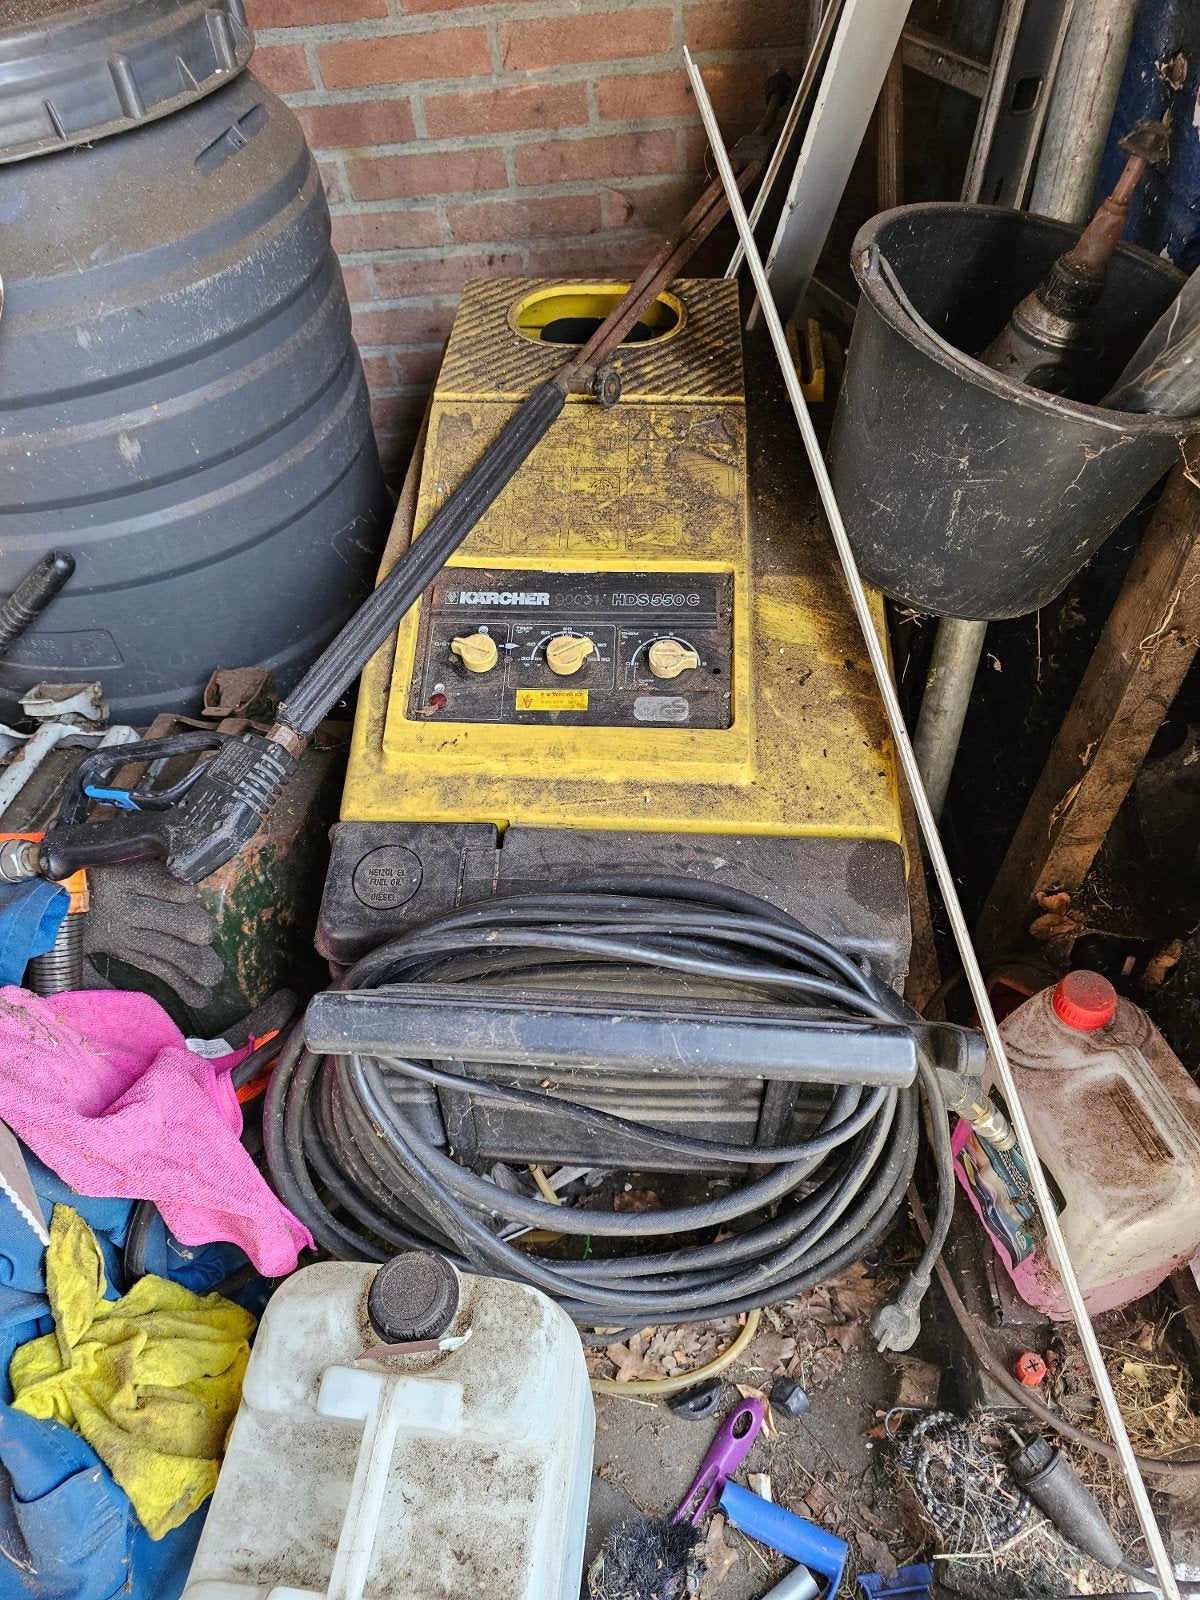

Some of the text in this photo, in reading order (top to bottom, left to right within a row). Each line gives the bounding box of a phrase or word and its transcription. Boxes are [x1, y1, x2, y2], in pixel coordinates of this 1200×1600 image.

[369, 878, 402, 886] FUEL OIL
[370, 892, 396, 902] DIESEL
